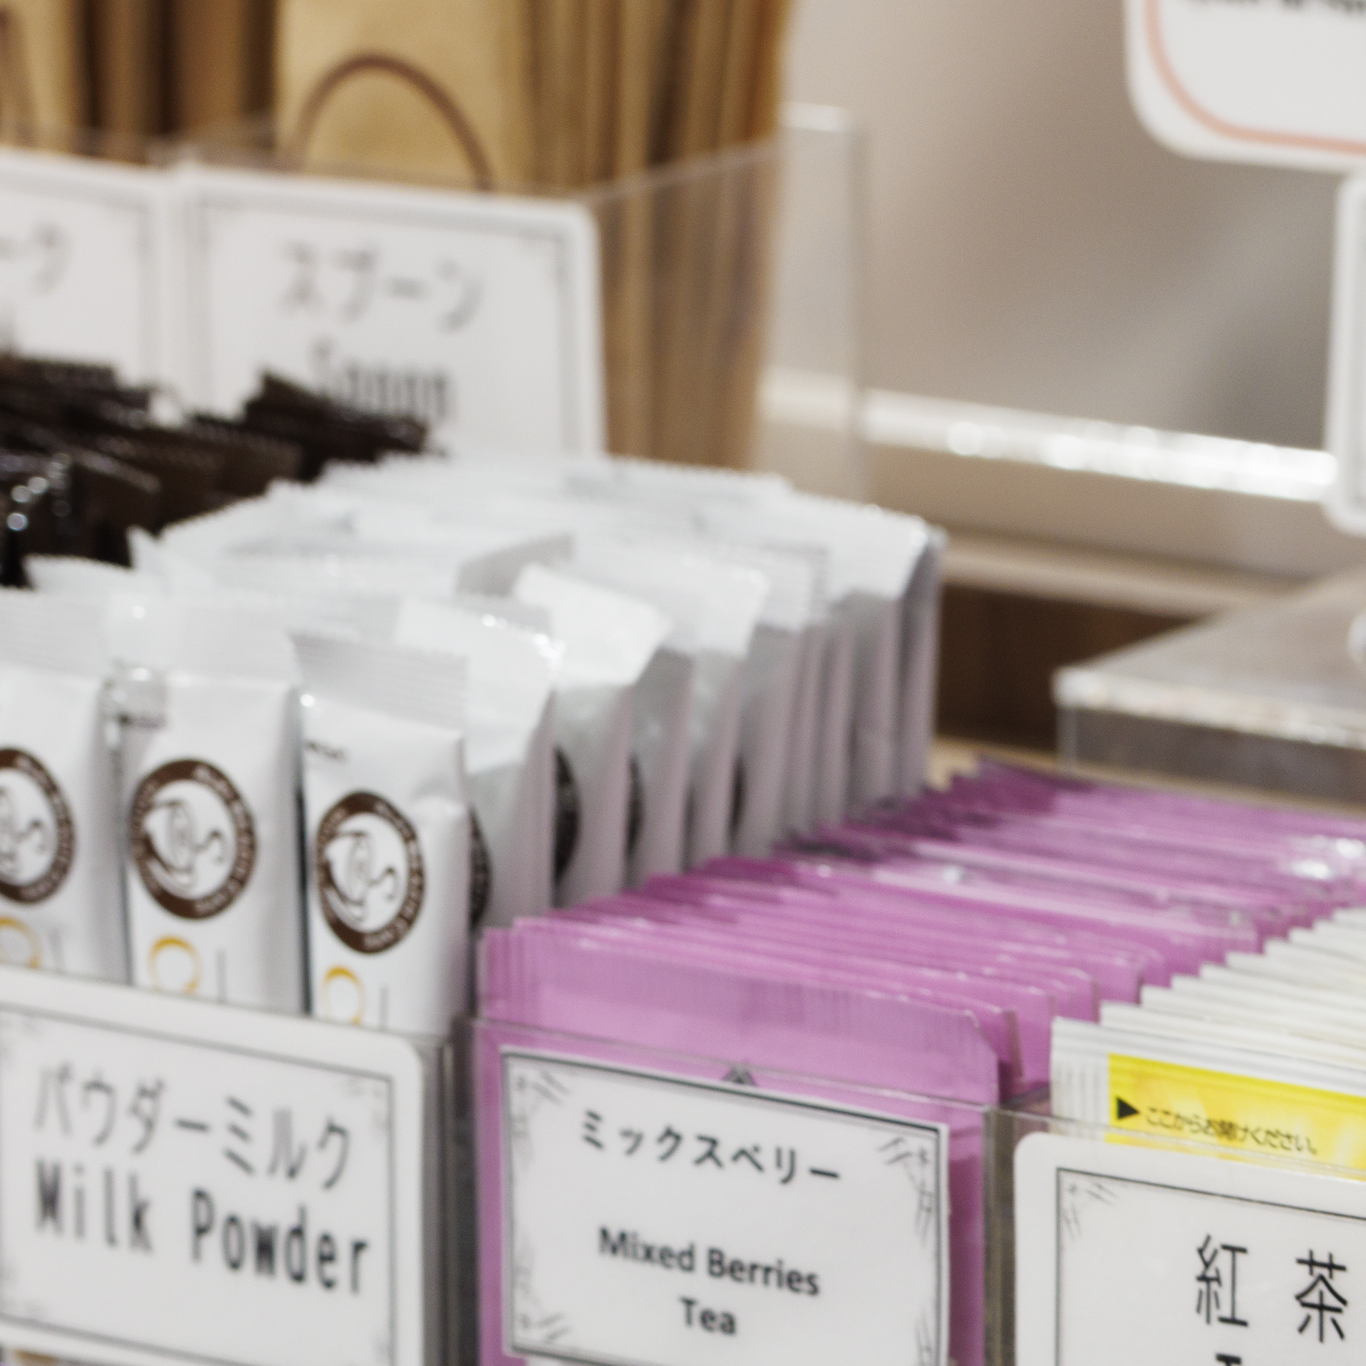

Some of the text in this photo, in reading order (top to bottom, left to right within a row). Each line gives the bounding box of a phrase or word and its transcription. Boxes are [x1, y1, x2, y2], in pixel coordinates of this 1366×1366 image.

[34, 1061, 354, 1191] パウダーミルク
[580, 1109, 841, 1186] ミックスベリー
[36, 1156, 372, 1297] Milk Powder
[598, 1228, 821, 1298] Mixed Berries
[681, 1298, 737, 1336] Tea
